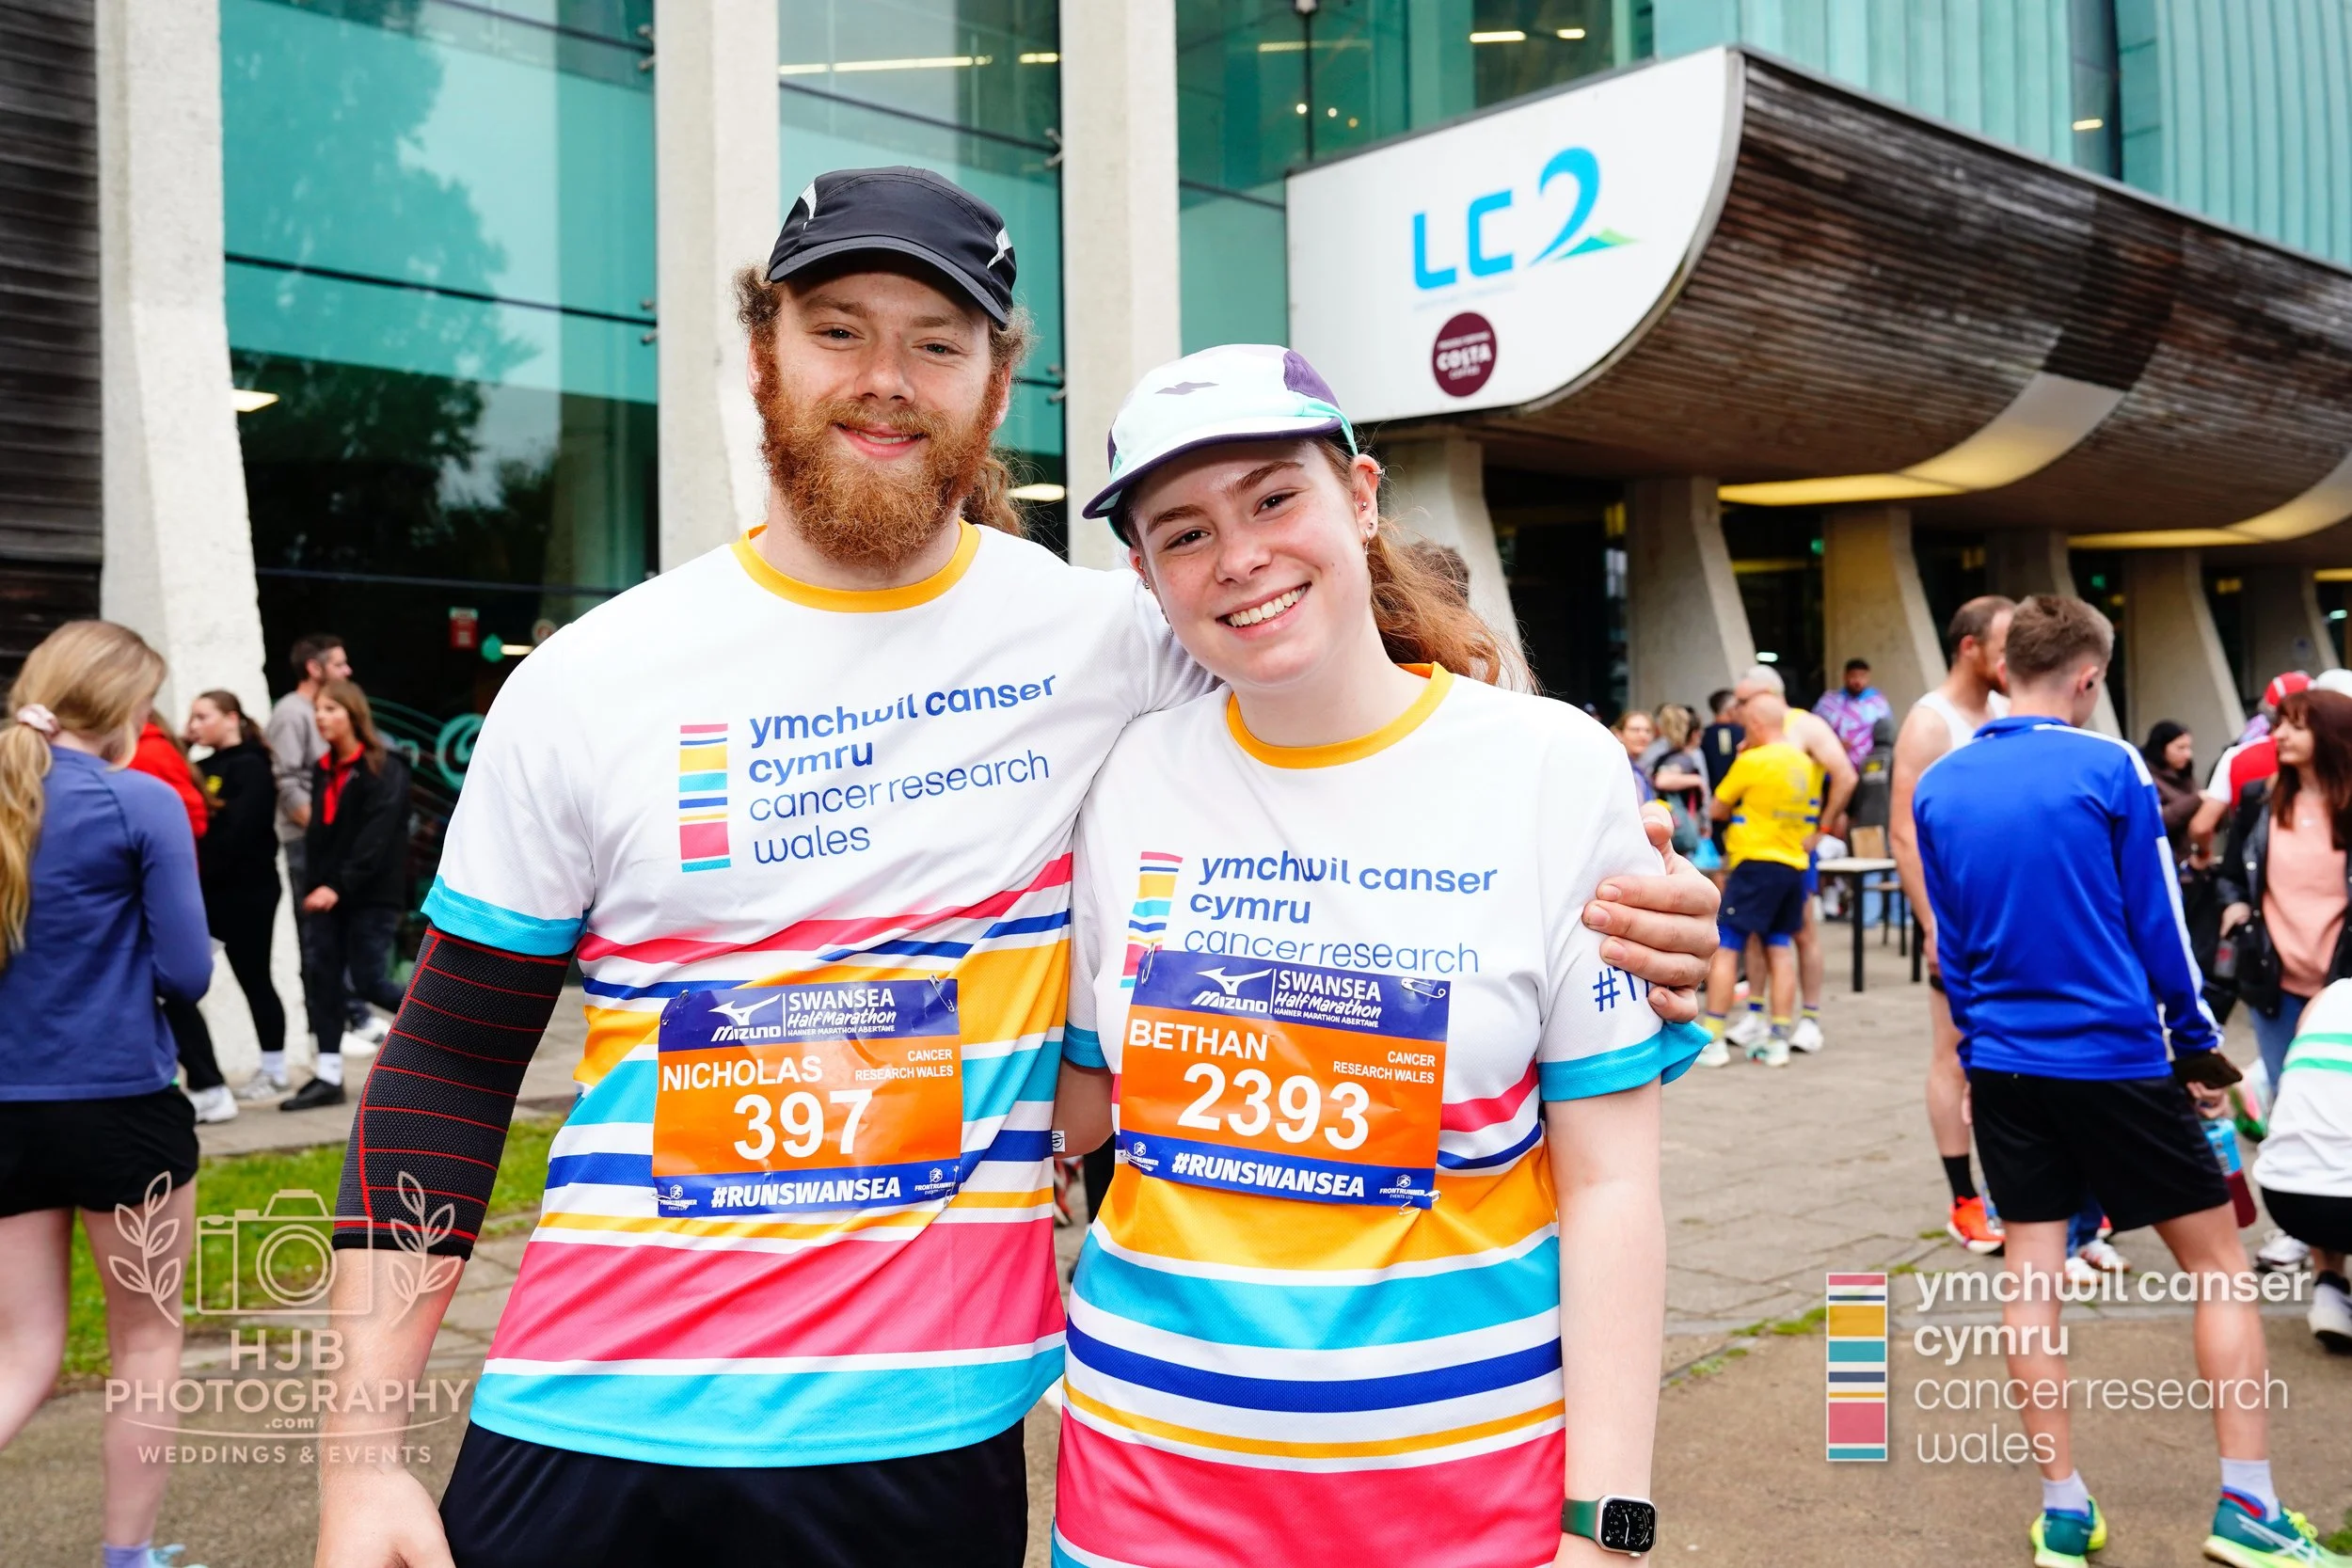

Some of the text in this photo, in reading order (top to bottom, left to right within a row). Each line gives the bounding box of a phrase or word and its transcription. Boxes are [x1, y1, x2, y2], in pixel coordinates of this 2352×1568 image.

[1436, 341, 1493, 372] COSTA
[749, 674, 1057, 748] ymchwil canser
[749, 741, 874, 785] cymru
[749, 749, 1050, 822] cancer research
[754, 825, 871, 864] wales
[1198, 850, 1498, 895] ymchwil canser
[1189, 893, 1311, 925] cymru
[1184, 929, 1480, 974] cancer research
[788, 989, 896, 1011] SWANSEA
[1191, 990, 1268, 1013] MIZUNO
[1278, 970, 1382, 1002] SWANSEA
[1274, 1007, 1302, 1018] HANNER
[1302, 1011, 1341, 1023] MARATHON
[710, 1025, 782, 1041] MIZUNO
[787, 1029, 816, 1037] HANNER
[818, 1027, 857, 1036] MARATHON
[1128, 1019, 1268, 1061] BETHAN
[907, 1049, 953, 1062] CANCER
[1387, 1051, 1436, 1067] CANCER
[662, 1055, 823, 1091] NICHOLAS
[855, 1065, 954, 1082] RESEARCH WALES
[1333, 1061, 1435, 1085] RESEARCH WALES
[1176, 1063, 1371, 1151] 2393
[733, 1089, 873, 1161] 397
[1171, 1151, 1365, 1197] #RUNSWANSEA
[710, 1177, 901, 1208] #RUNSWANSEA
